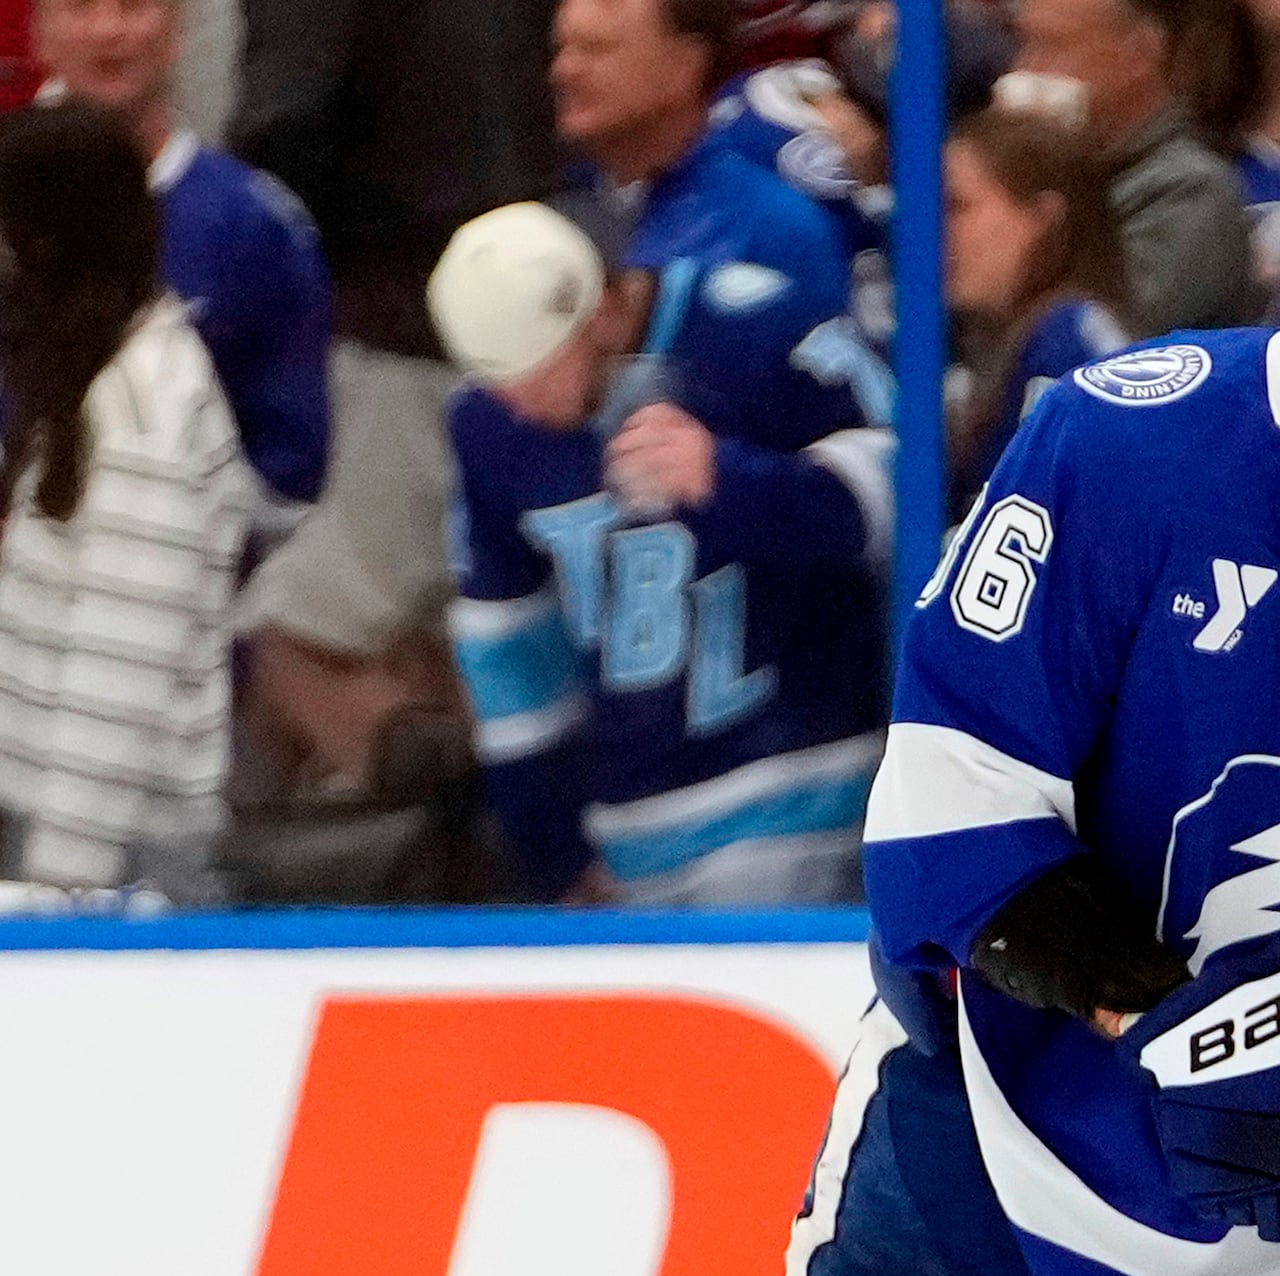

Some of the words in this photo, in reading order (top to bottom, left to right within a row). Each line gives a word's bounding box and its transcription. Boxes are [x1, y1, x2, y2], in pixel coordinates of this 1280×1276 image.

[522, 492, 779, 735] TBL
[915, 480, 1054, 643] 6
[1172, 593, 1206, 619] the
